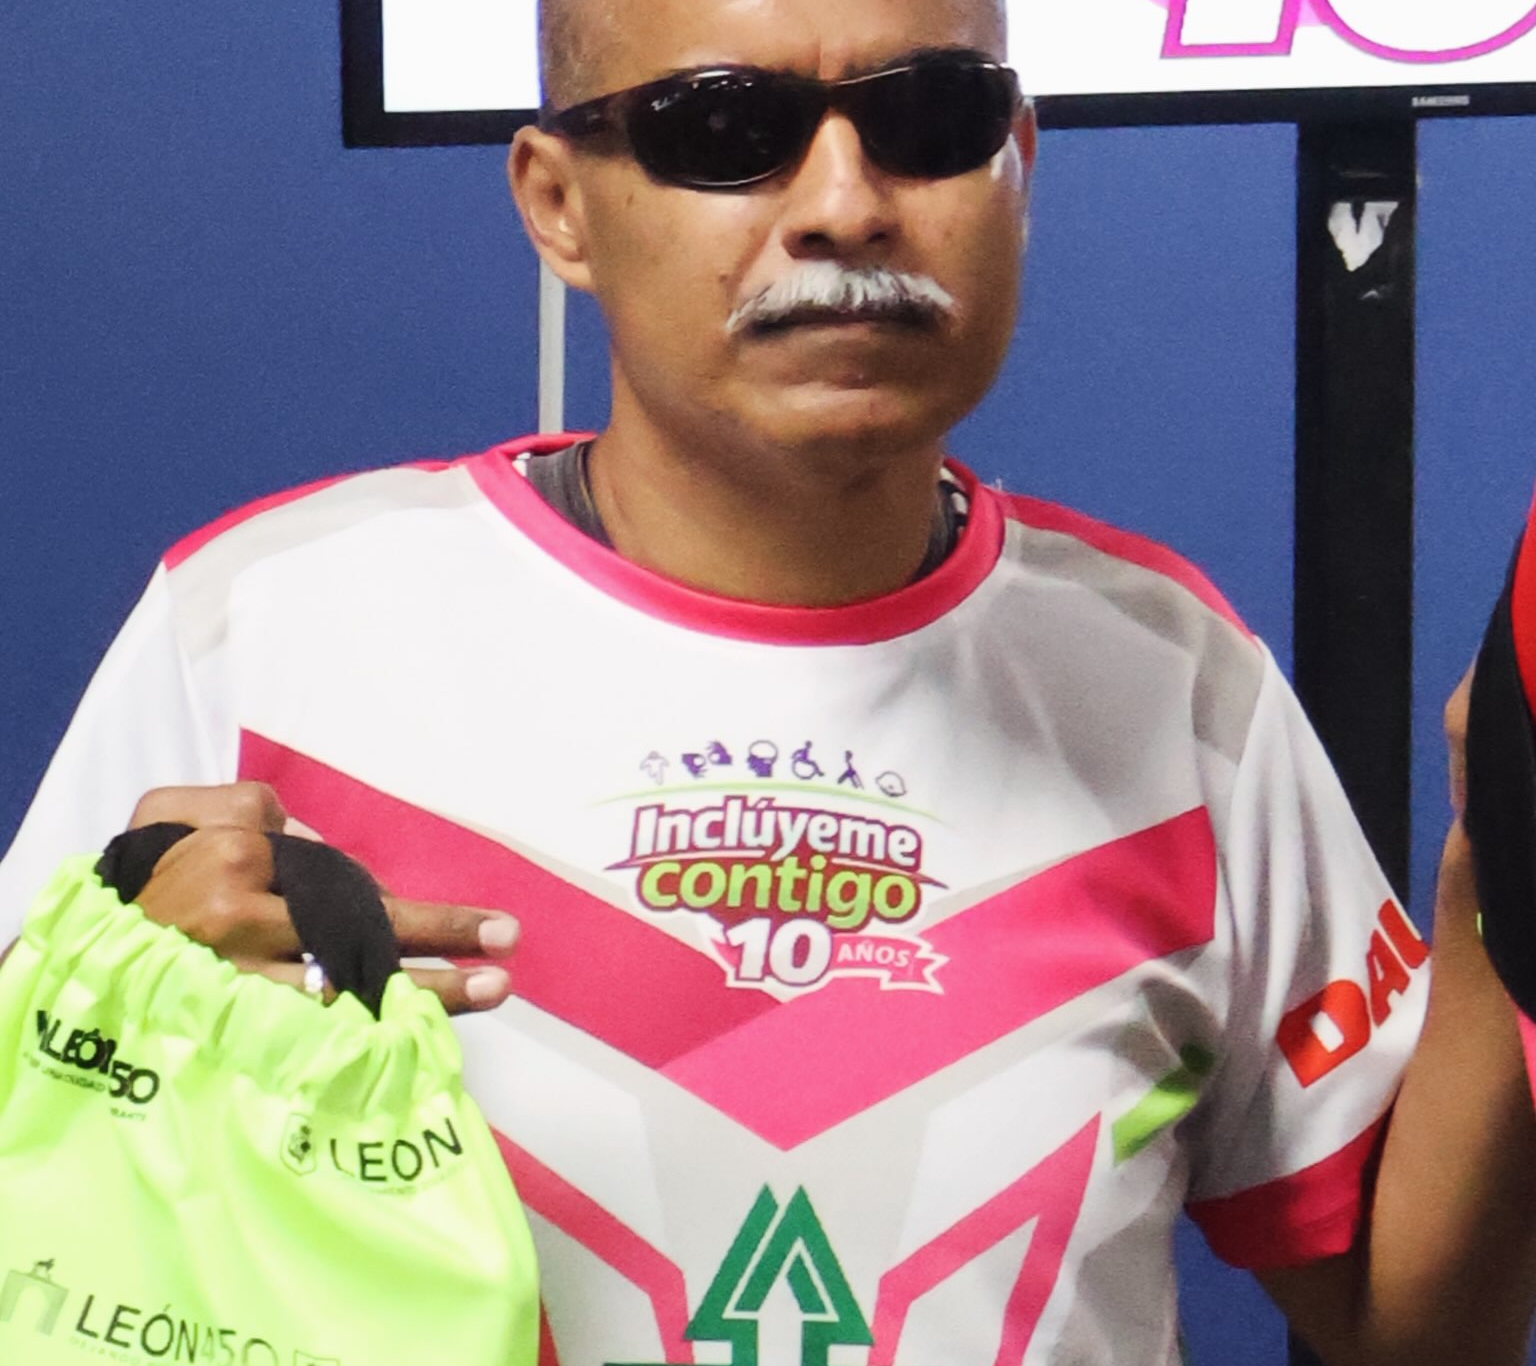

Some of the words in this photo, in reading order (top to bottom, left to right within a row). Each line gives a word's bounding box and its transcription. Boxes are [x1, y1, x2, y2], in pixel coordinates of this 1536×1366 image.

[634, 798, 919, 866] Inclúyeme
[642, 855, 917, 928] contigo
[726, 918, 832, 986] 10
[837, 939, 910, 967] AÑOS
